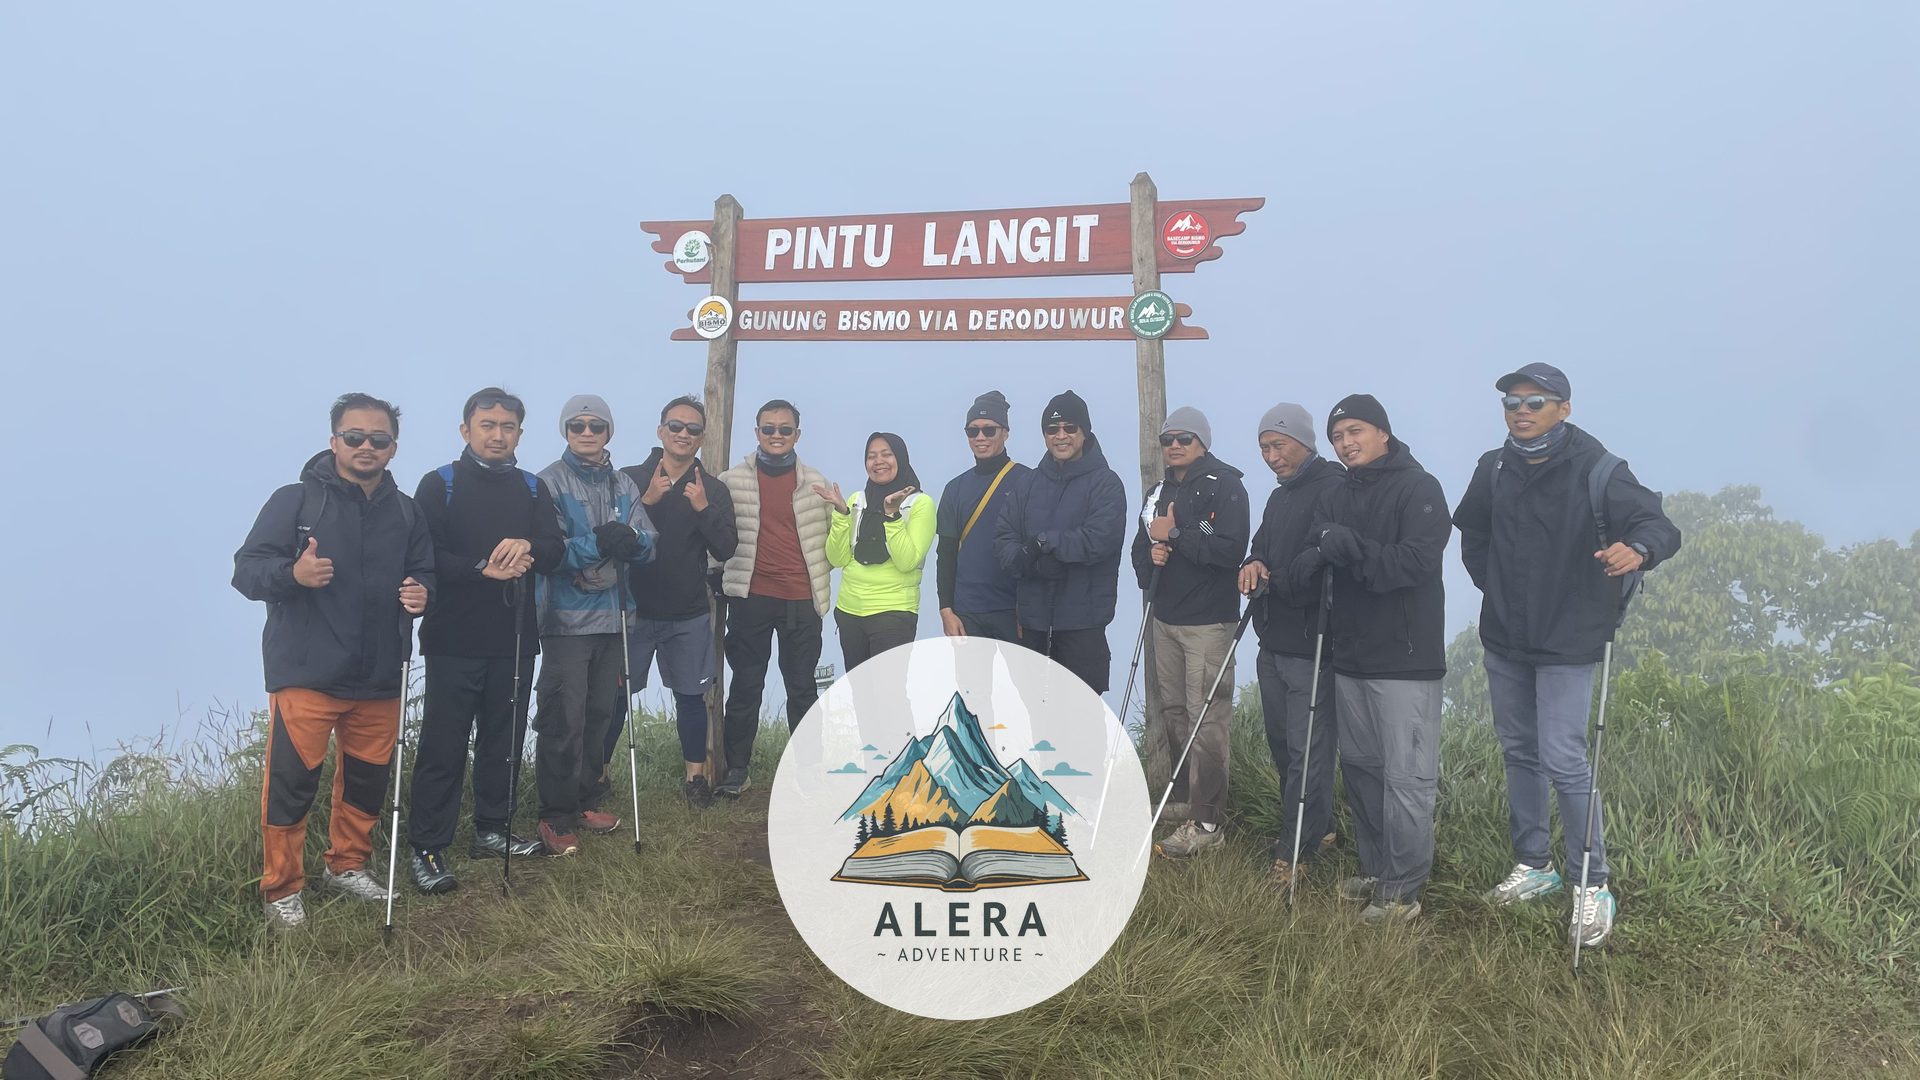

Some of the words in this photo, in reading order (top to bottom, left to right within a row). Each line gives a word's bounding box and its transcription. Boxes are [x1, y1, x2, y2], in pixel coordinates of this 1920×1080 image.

[765, 224, 894, 270] PINTU
[922, 215, 1099, 267] LANGIT
[699, 319, 726, 327] BISMO
[738, 310, 826, 331] GUNUNG
[838, 310, 910, 331] BISMO
[919, 310, 958, 331] VIA
[969, 307, 1125, 331] DERODUWUR
